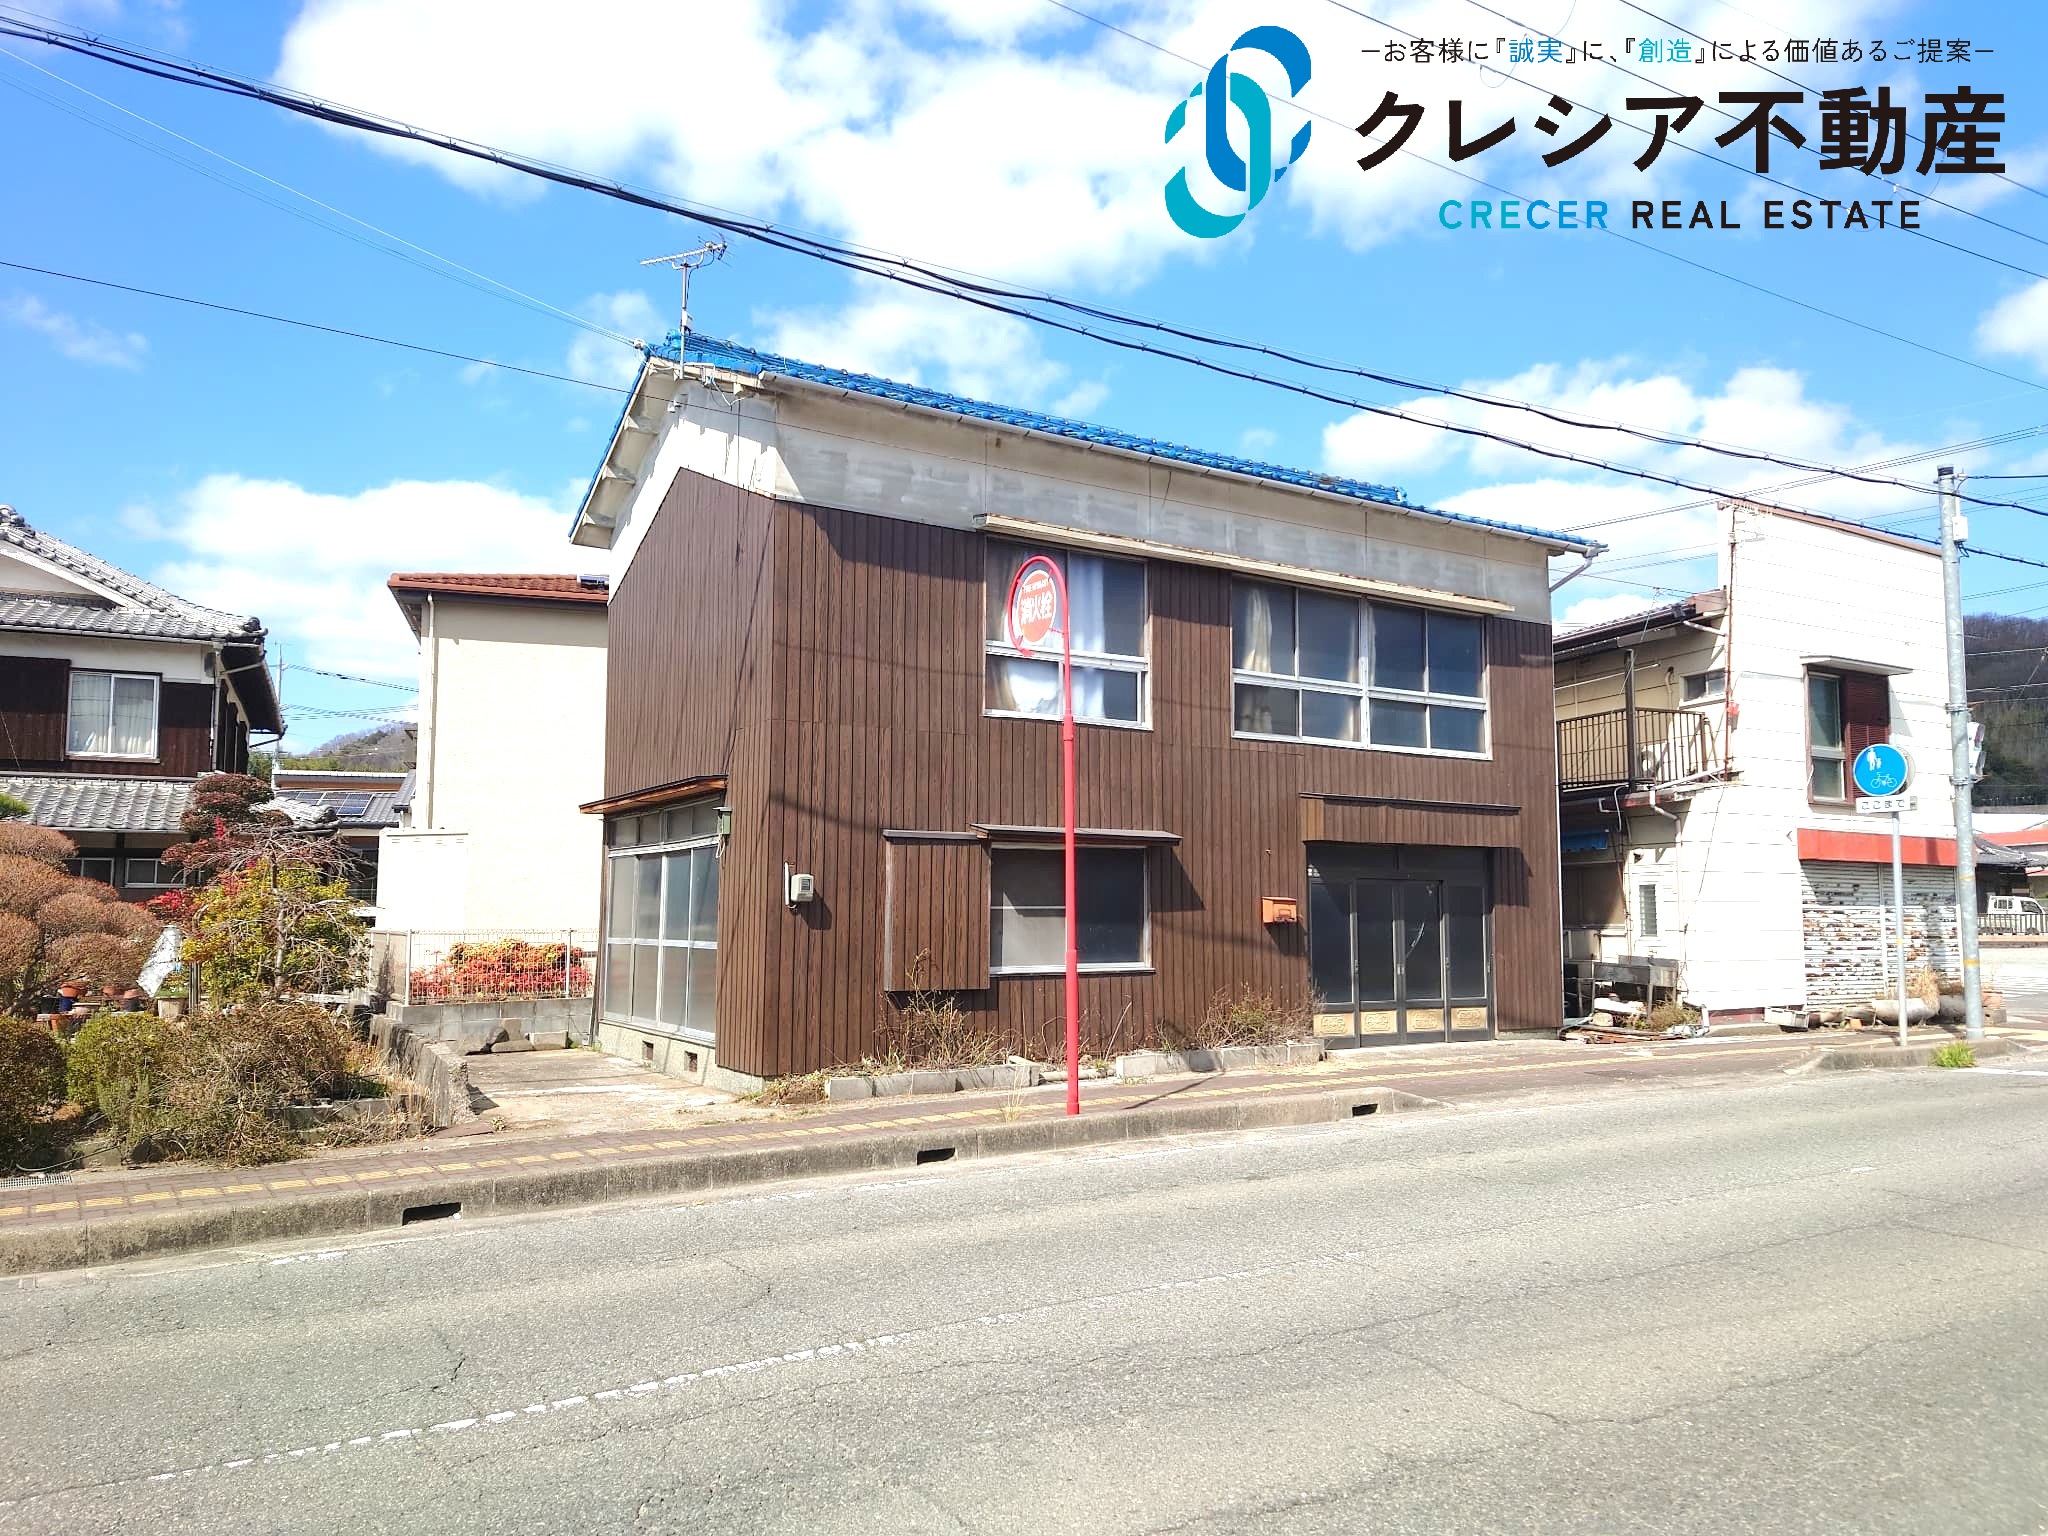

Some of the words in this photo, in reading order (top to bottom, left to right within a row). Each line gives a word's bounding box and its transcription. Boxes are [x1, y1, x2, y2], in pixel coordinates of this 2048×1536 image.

[1020, 591, 1053, 625] 消火栓
[1861, 799, 1905, 811] ここまで
